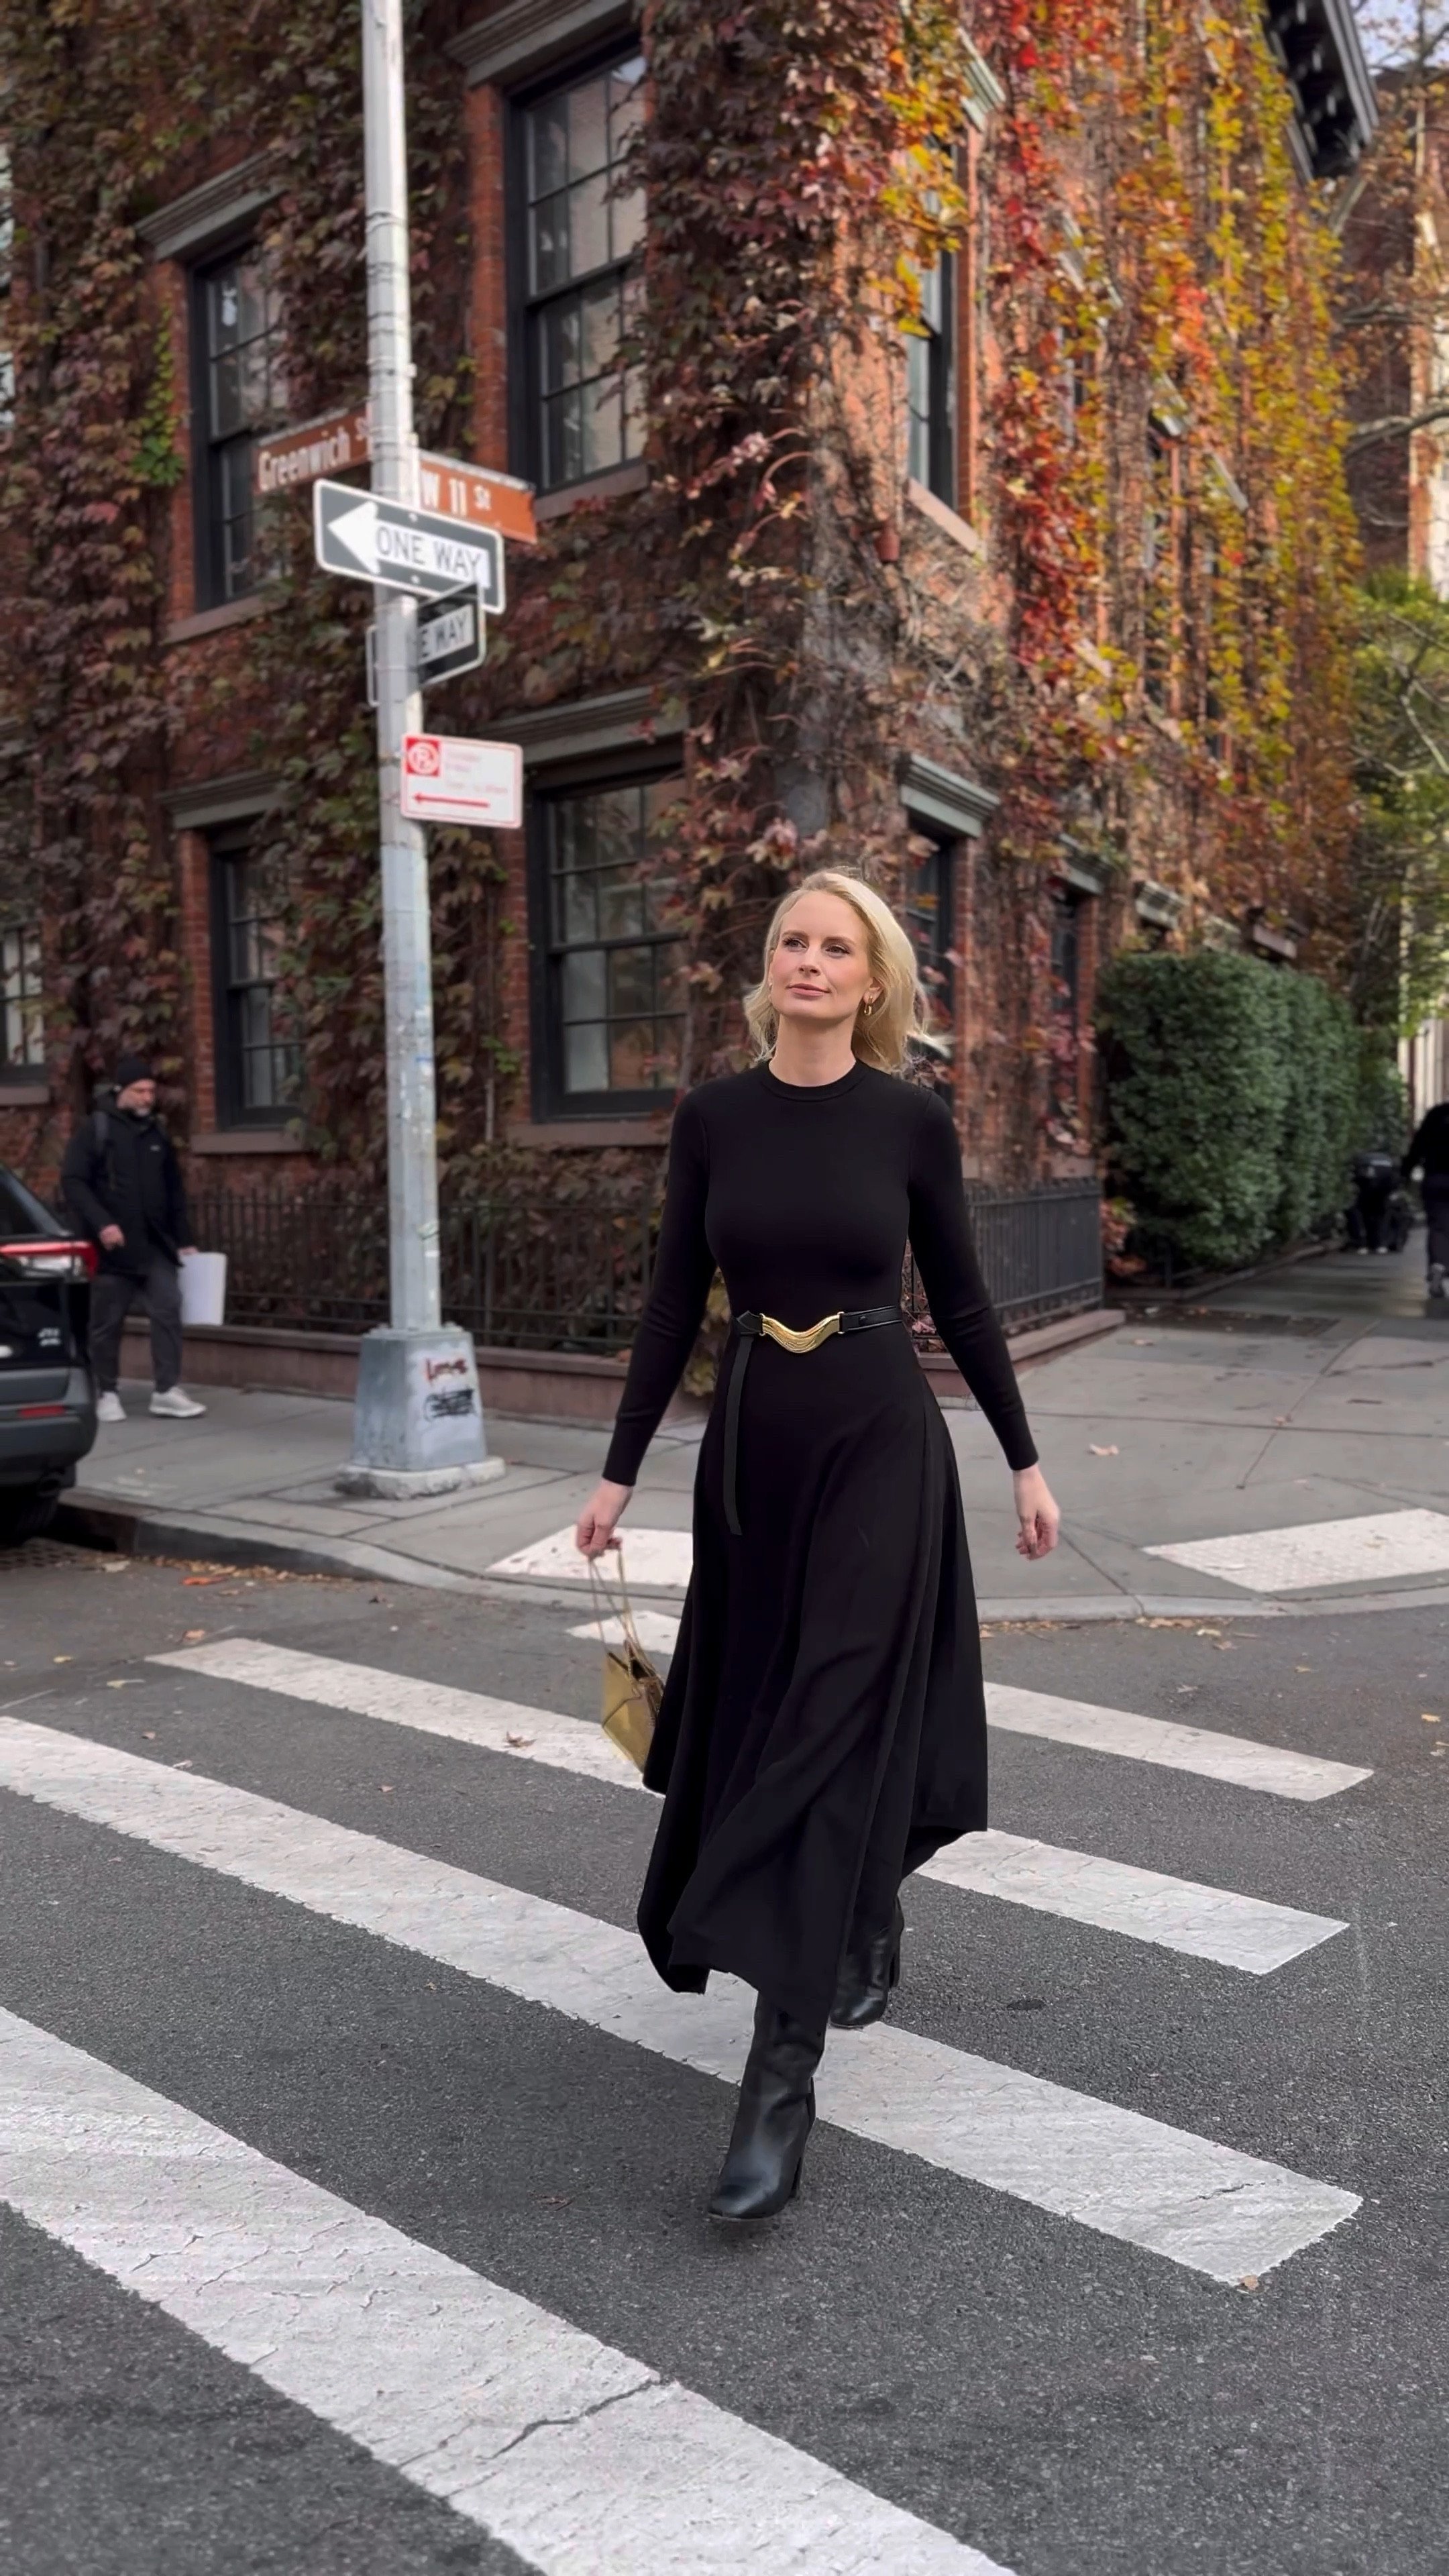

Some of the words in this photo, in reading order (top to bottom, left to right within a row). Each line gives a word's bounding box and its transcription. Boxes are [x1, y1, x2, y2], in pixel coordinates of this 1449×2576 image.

[258, 425, 351, 492] Greenwich
[354, 416, 370, 441] S
[421, 470, 440, 509] W
[448, 477, 468, 517] 11
[474, 484, 492, 511] St
[376, 526, 425, 565] ONE
[433, 539, 481, 580] WAY
[433, 610, 468, 652] WAY
